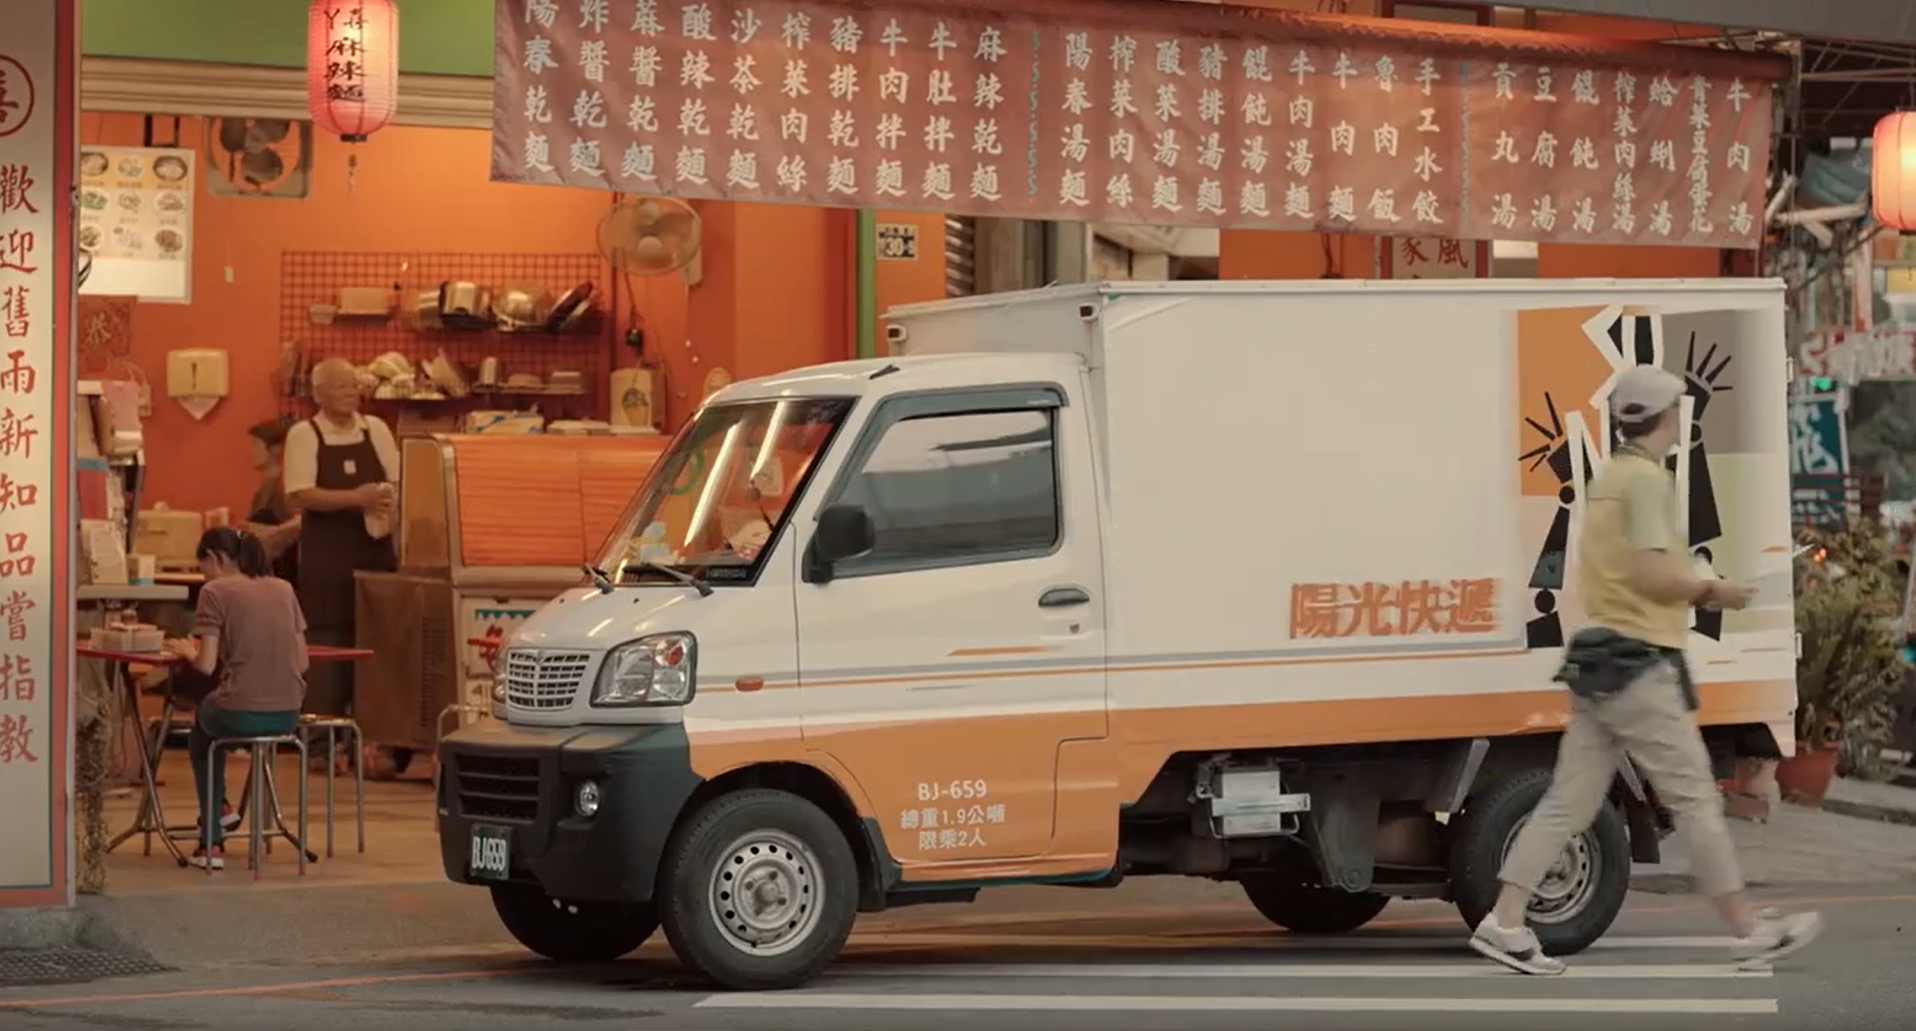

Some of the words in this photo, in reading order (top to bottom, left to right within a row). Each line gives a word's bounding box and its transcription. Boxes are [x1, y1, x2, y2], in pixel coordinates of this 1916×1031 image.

[524, 0, 559, 173] 陽春乾麵
[569, 0, 610, 178] 炸醬乾麵
[675, 3, 717, 185] 酸辣乾麵
[726, 9, 763, 190] 沙茶乾麵
[776, 12, 812, 194] 榨菜肉絲
[827, 15, 863, 195] 豬排乾麵
[875, 18, 909, 197] 牛肉拌麵
[921, 22, 957, 201] 牛肚拌麵
[969, 26, 1008, 201] 麻辣乾麵
[1059, 32, 1094, 207] 陽春湯麵
[1106, 35, 1138, 209] 榨菜肉絲
[1152, 39, 1186, 213] 酸菜湯麵
[1197, 43, 1228, 217] 豬排湯麵
[1240, 45, 1273, 218] 餛飩湯麵
[1284, 50, 1316, 219] 牛肉湯麵
[1328, 52, 1359, 222] 牛肉麵
[1366, 55, 1401, 223] 魯肉飯
[1412, 58, 1444, 225] 手工水餃
[1490, 62, 1519, 231] 貢丸湯
[1530, 66, 1558, 232] 豆腐湯
[1569, 70, 1600, 234] 餛飩湯
[1612, 71, 1639, 235] 榨菜肉絲湯
[1726, 77, 1754, 236] 牛肉湯
[1289, 577, 1503, 640] 陽光快遞
[918, 779, 987, 801] BJ-659
[919, 827, 988, 850] 限乘2人
